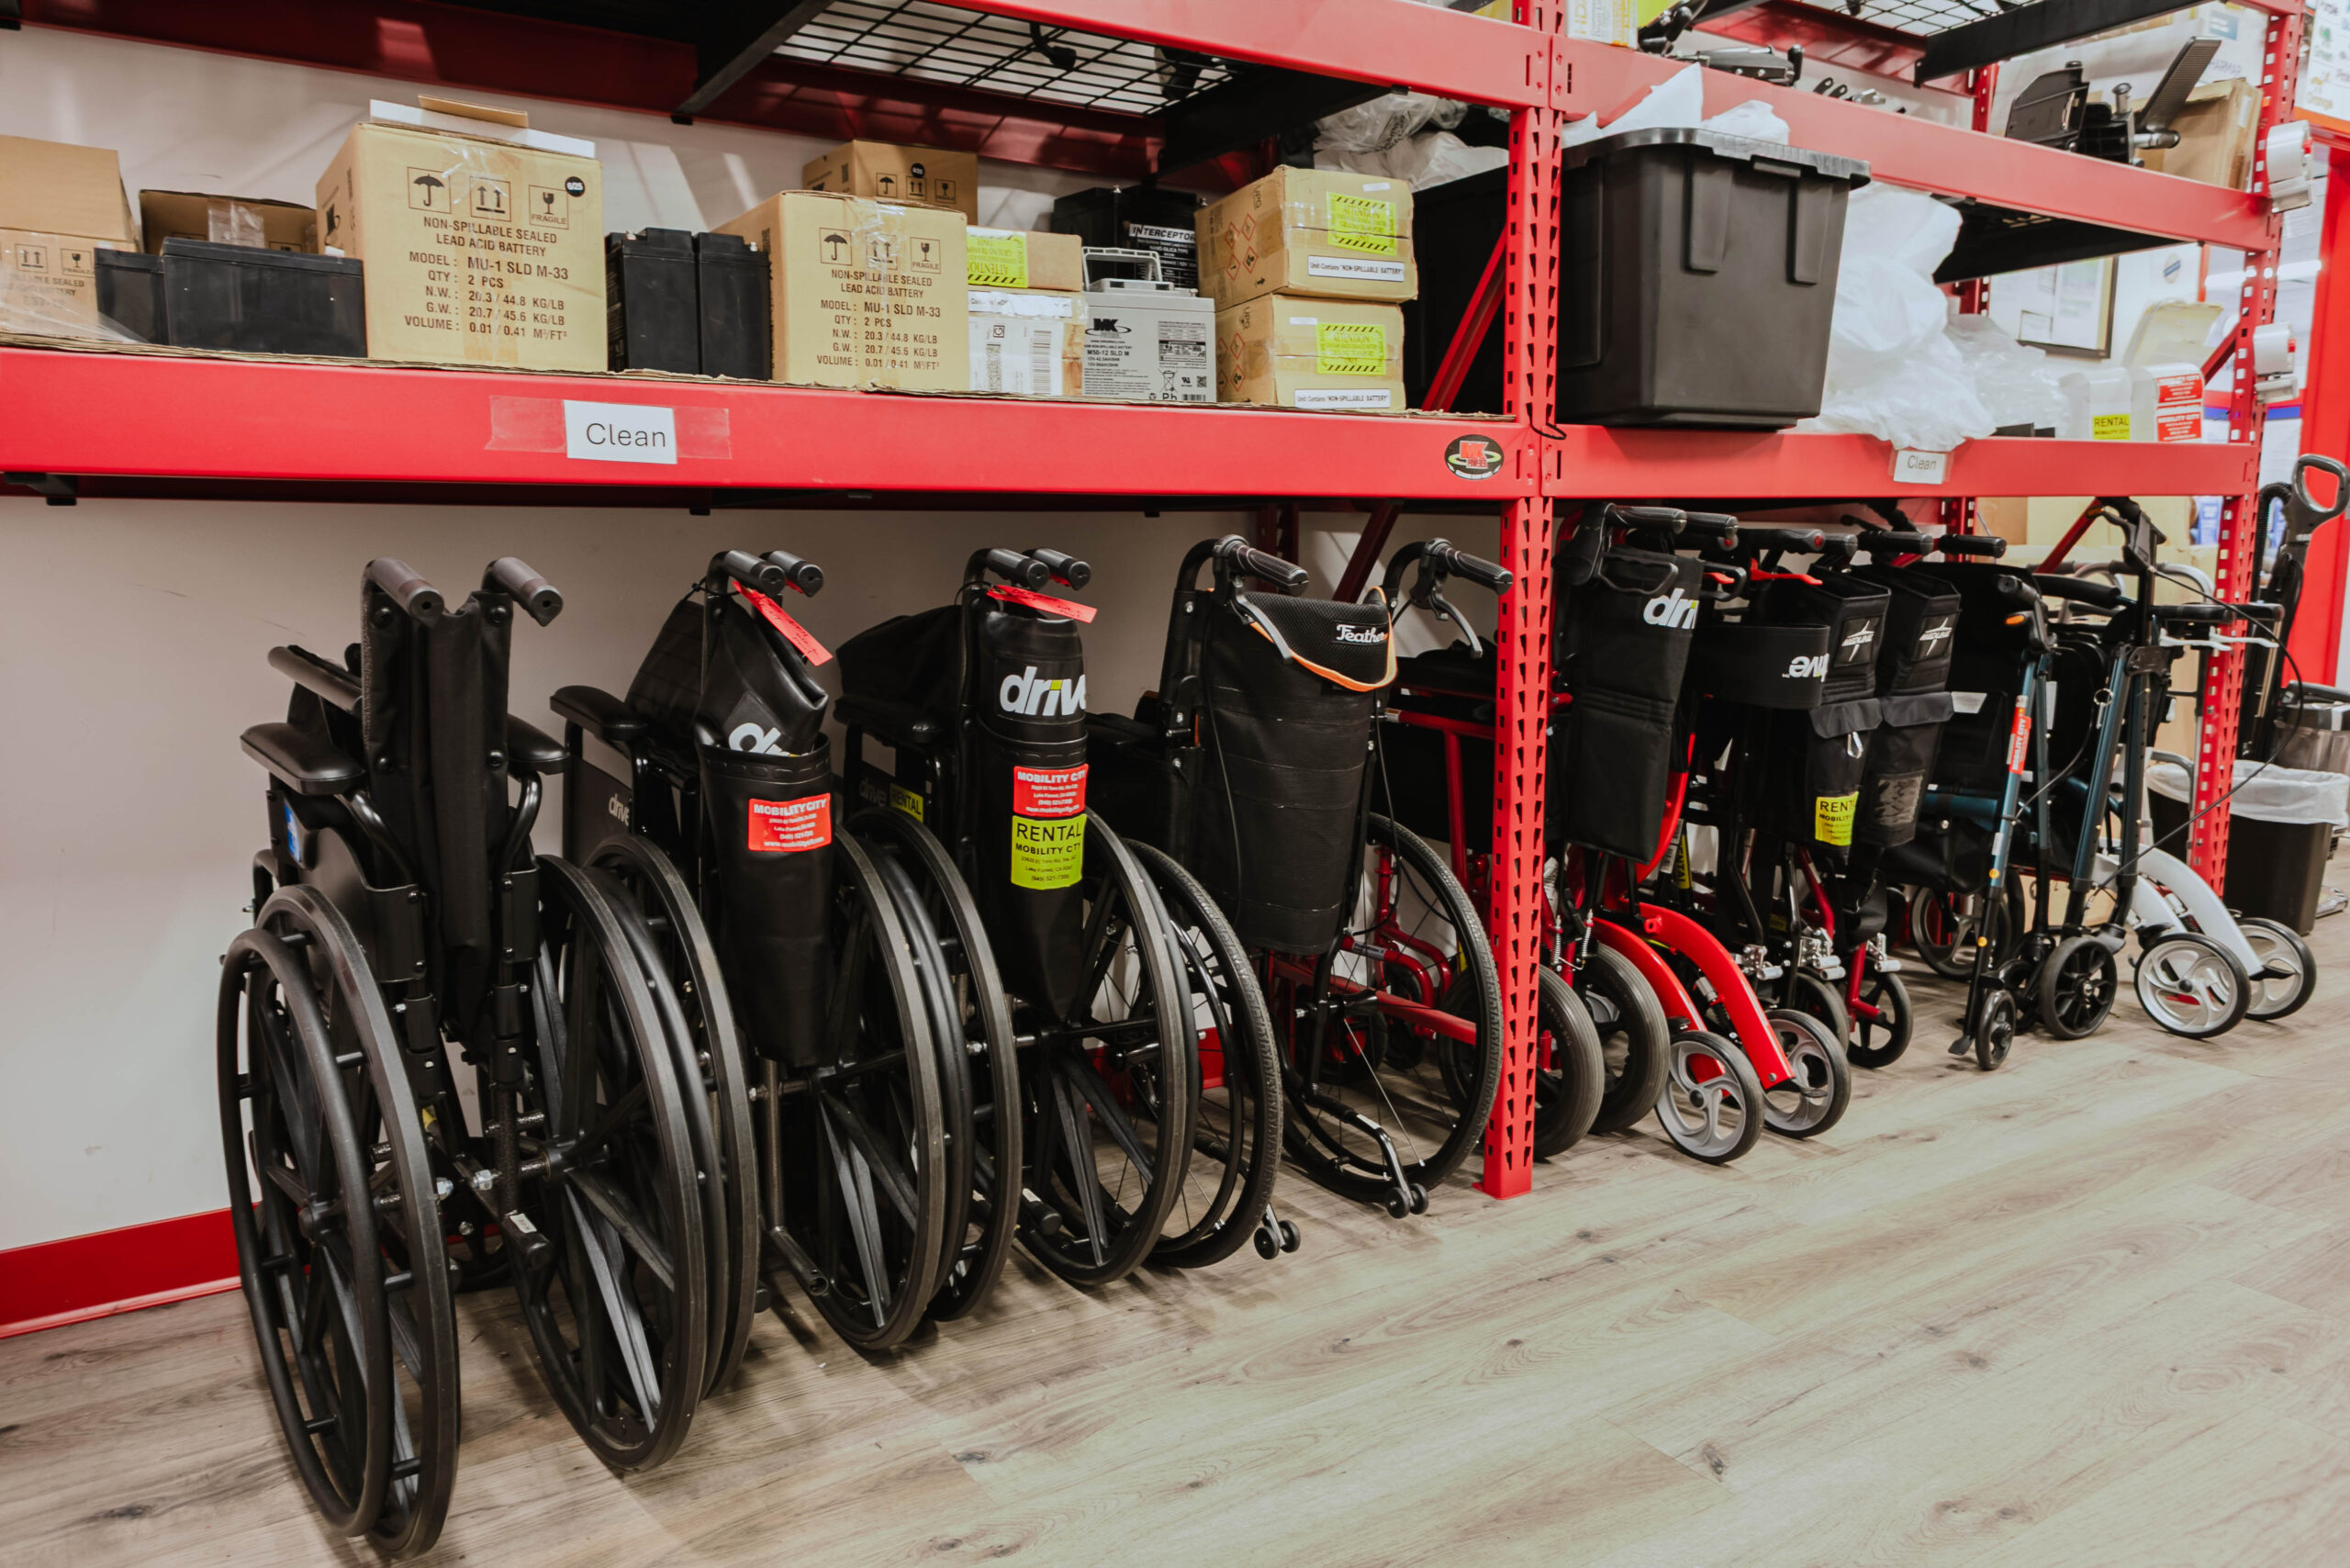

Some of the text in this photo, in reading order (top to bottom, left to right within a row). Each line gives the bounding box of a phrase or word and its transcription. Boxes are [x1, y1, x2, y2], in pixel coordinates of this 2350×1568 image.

[531, 214, 567, 225] FRAGILE
[423, 217, 557, 244] NON-SPILLABLE SEALED
[436, 233, 546, 257] LEAD ACID BATTERY
[409, 252, 569, 280] MODEL MU-1 SLD M-33
[912, 262, 940, 270] FRAGILE
[968, 261, 1008, 275] ATTENTIO
[428, 270, 504, 288] QTY 2 PCS
[901, 274, 933, 286] SEALED
[841, 283, 924, 299] LEAD ACID BATTERY
[468, 290, 492, 303] 20.3
[503, 295, 526, 307] 44.8
[532, 297, 565, 310] KG/LB
[469, 307, 492, 318] 20.7
[503, 310, 526, 322] 45.6
[533, 313, 565, 326] KG/LB
[821, 299, 941, 318] MODEL MU-1 SLD M-33
[404, 315, 453, 330] VOLUME
[469, 322, 492, 334] 0.01
[504, 325, 525, 337] 0.41
[834, 315, 891, 328] QTY 2 PCS
[865, 330, 883, 341] 20.3
[890, 332, 909, 342] 44.8
[913, 334, 937, 344] KG/LB
[865, 344, 883, 354] 20.7
[913, 347, 937, 358] KG/LB
[817, 354, 853, 366] VOLUME
[865, 358, 882, 368] 0.01
[2094, 417, 2129, 427] RENTAL
[587, 422, 666, 447] Clean
[1908, 454, 1937, 470] Clean
[1643, 588, 1699, 630] dri
[1017, 771, 1069, 783] MOBILITY
[754, 799, 827, 816] MOBILITY CITY
[1819, 801, 1854, 812] RENT
[1819, 813, 1852, 822] MOBILIT
[1017, 823, 1081, 842] RENTAL
[1015, 843, 1063, 855] MOBILITY
